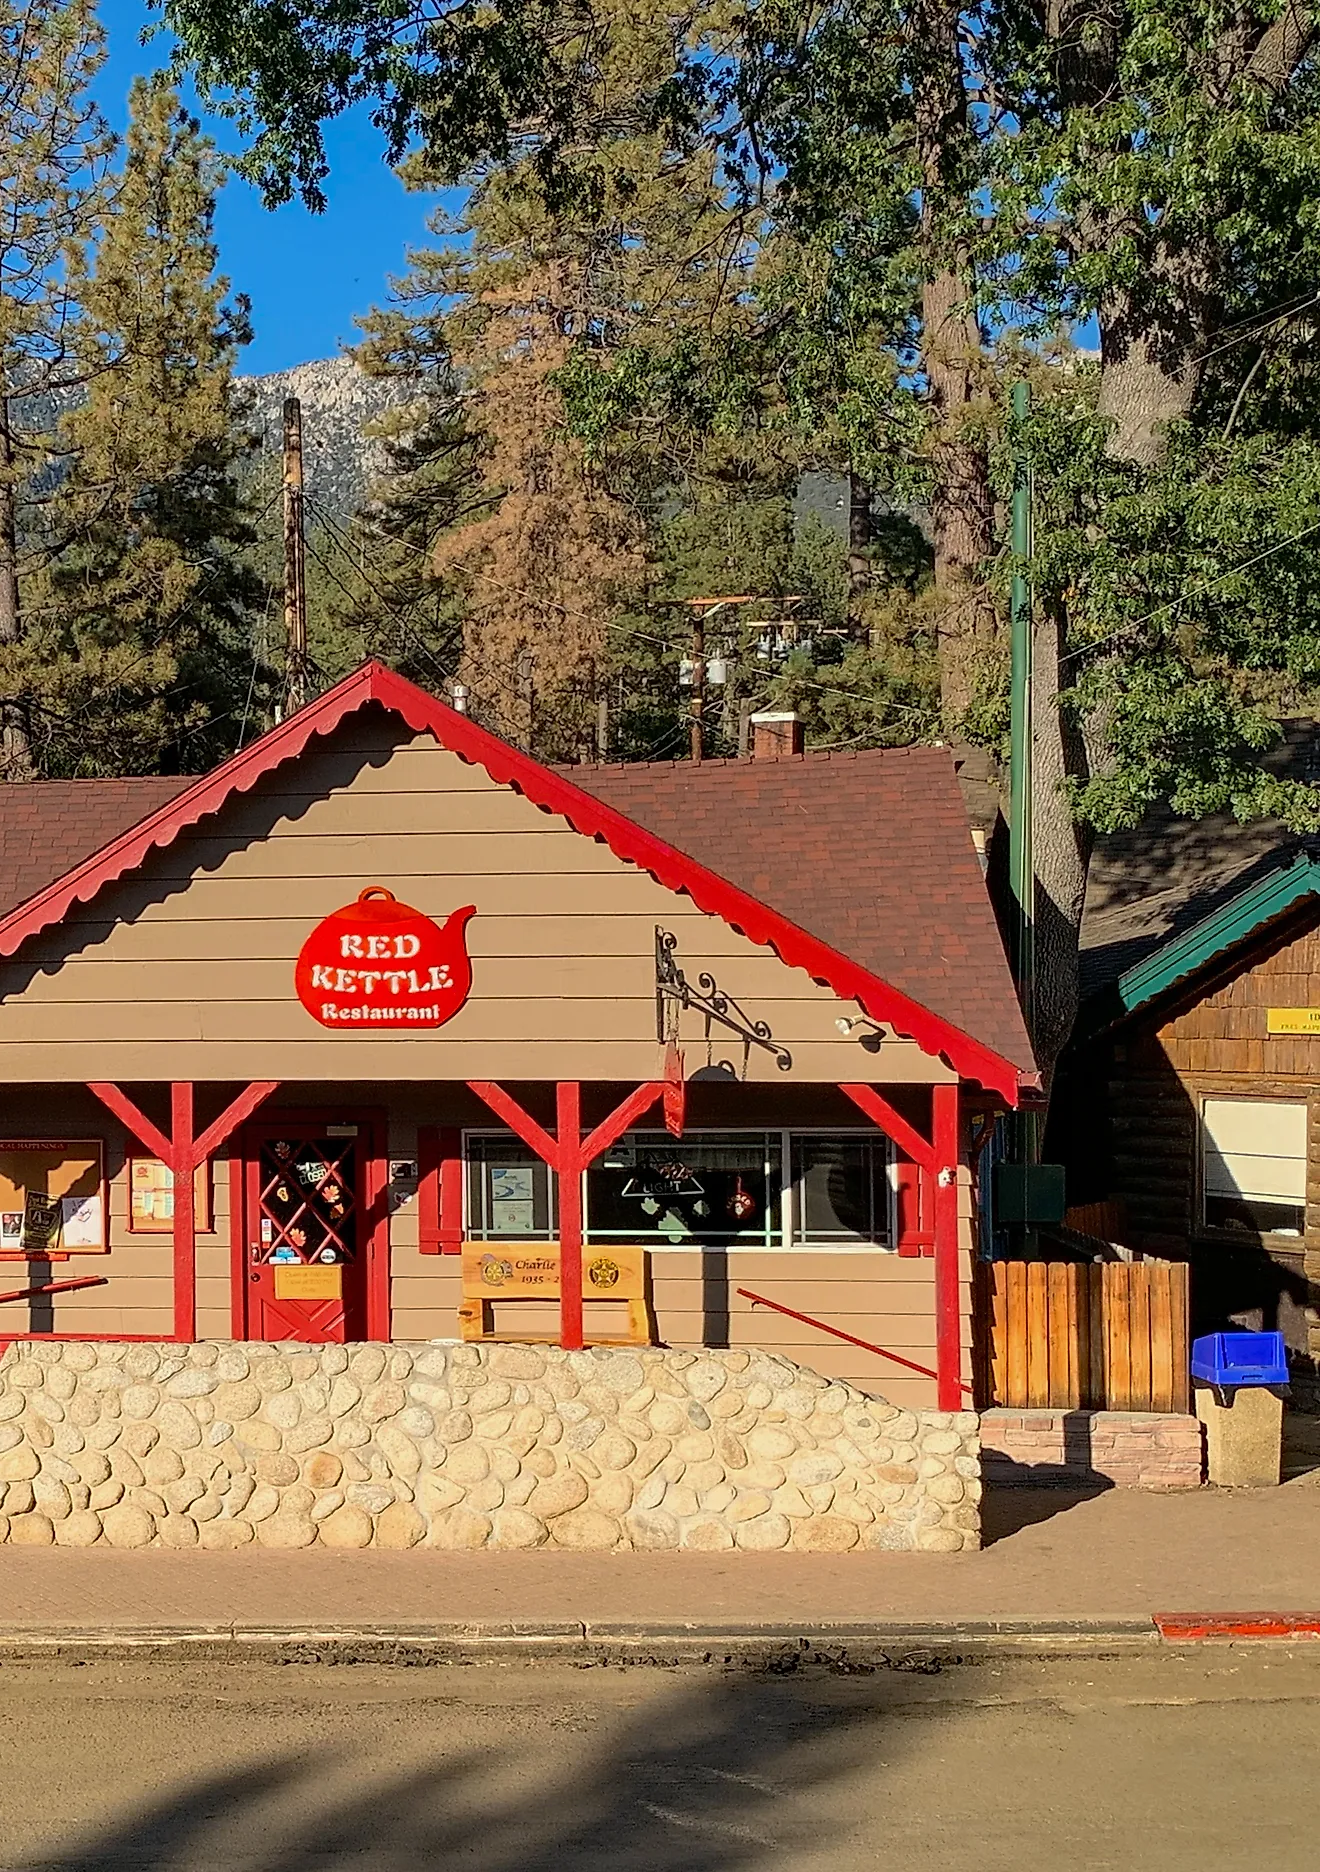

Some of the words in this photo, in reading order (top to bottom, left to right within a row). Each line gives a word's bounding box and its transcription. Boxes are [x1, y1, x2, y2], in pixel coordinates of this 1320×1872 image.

[340, 934, 421, 959] RED
[311, 964, 454, 995] KETTLE
[320, 1003, 440, 1020] Restaurant
[17, 1142, 65, 1150] HAPPENINGS
[643, 1180, 682, 1194] LIGHT
[515, 1257, 557, 1271] Charlie
[521, 1275, 544, 1284] 1935
